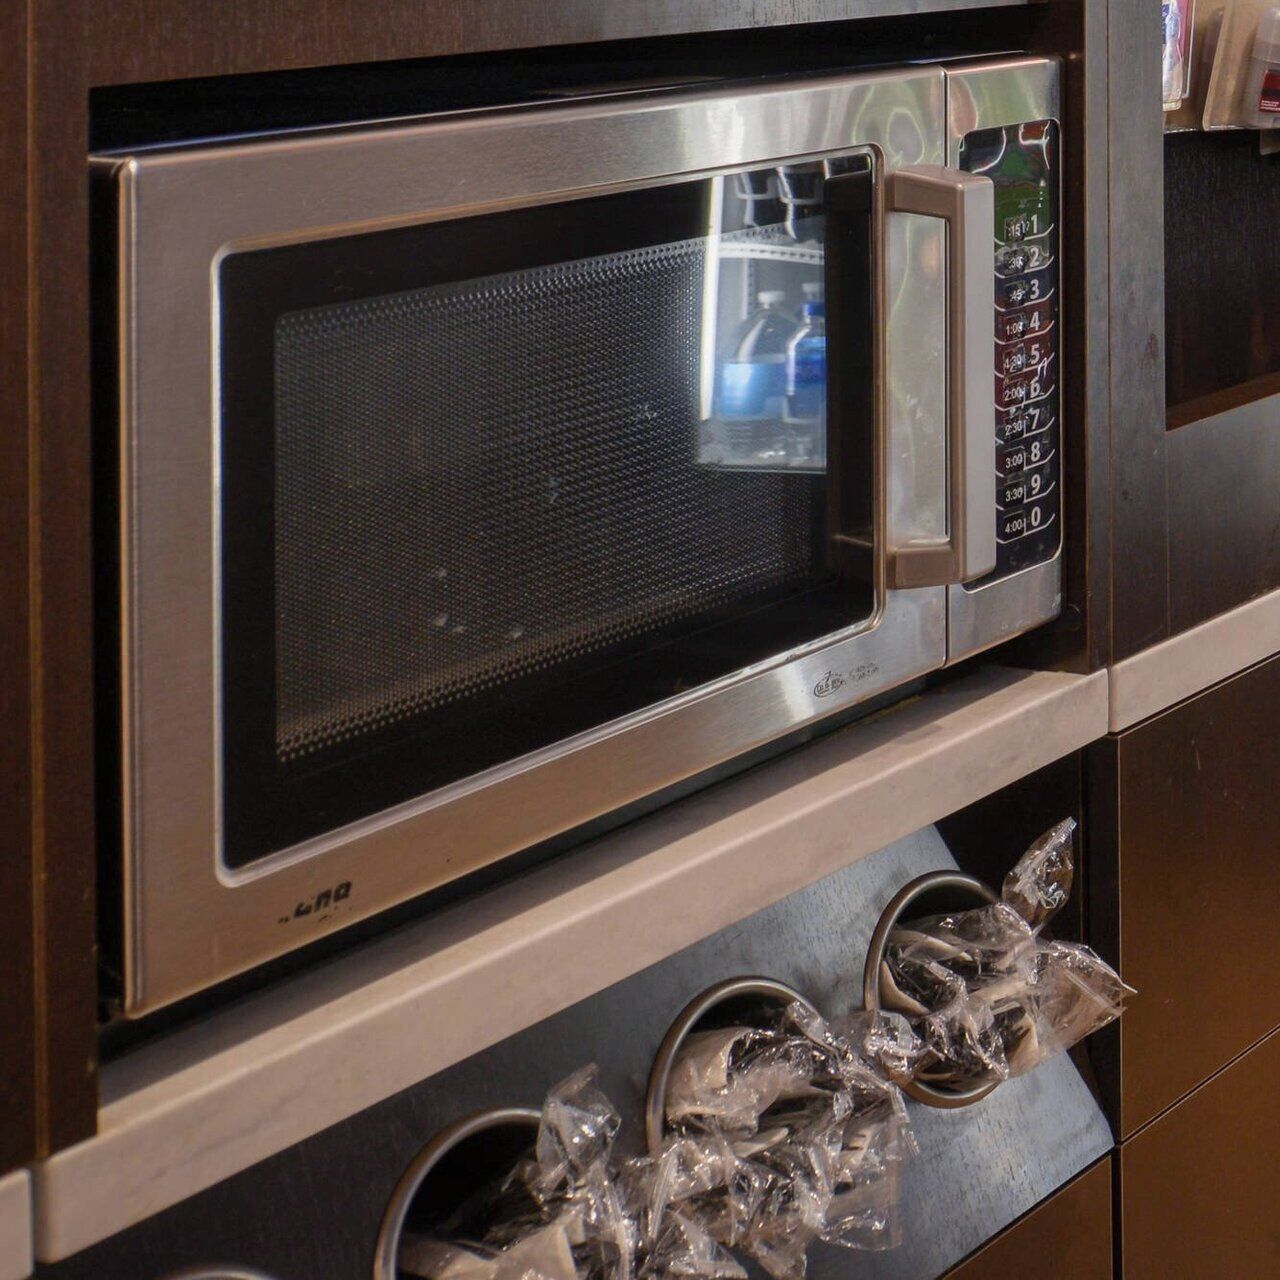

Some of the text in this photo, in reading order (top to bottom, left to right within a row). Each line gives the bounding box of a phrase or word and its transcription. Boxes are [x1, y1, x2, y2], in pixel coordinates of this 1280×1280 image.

[1031, 214, 1037, 234] 1
[1030, 248, 1039, 267] 2
[1030, 279, 1039, 299] 3
[1030, 312, 1040, 331] 4
[1031, 344, 1040, 364] 5
[1004, 386, 1023, 401] 2:00
[1031, 408, 1040, 429] 7
[1005, 421, 1023, 436] 2:30
[1005, 454, 1023, 469] 3:00
[1031, 442, 1040, 462] 8
[1031, 474, 1040, 494] 9
[1005, 487, 1023, 502] 3:30
[1031, 506, 1041, 526] 0
[1005, 519, 1022, 534] 4:00
